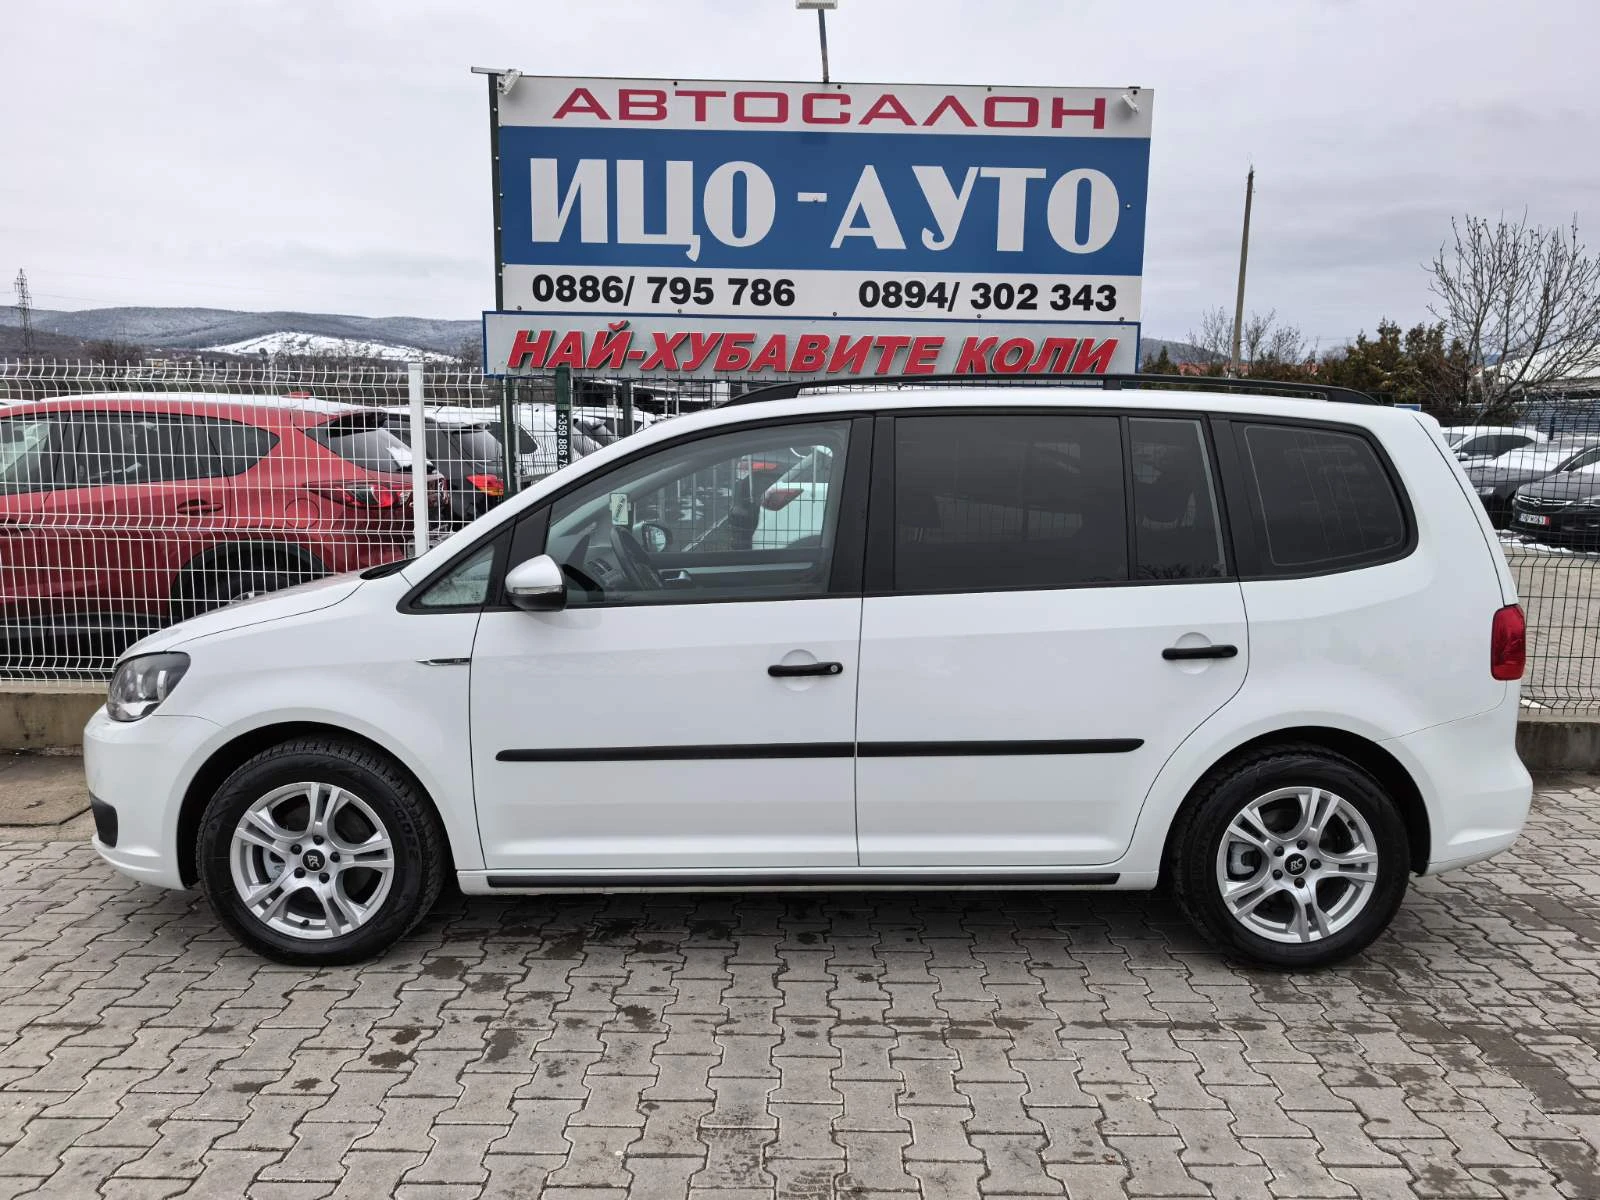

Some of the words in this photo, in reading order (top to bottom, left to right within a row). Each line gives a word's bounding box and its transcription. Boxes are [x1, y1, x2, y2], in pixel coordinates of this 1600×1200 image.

[554, 87, 1106, 129] АВТОСАЛОН
[532, 274, 635, 306] 0886/
[647, 277, 714, 306] 795
[728, 278, 796, 307] 786
[858, 280, 960, 312] 0894/
[970, 282, 1038, 310] 302
[1050, 284, 1117, 312] 343
[508, 320, 947, 375] НАЙ-ХУБАВИТЕ
[955, 336, 1119, 375] КОЛИ
[558, 413, 568, 436] +359
[558, 438, 568, 456] 886
